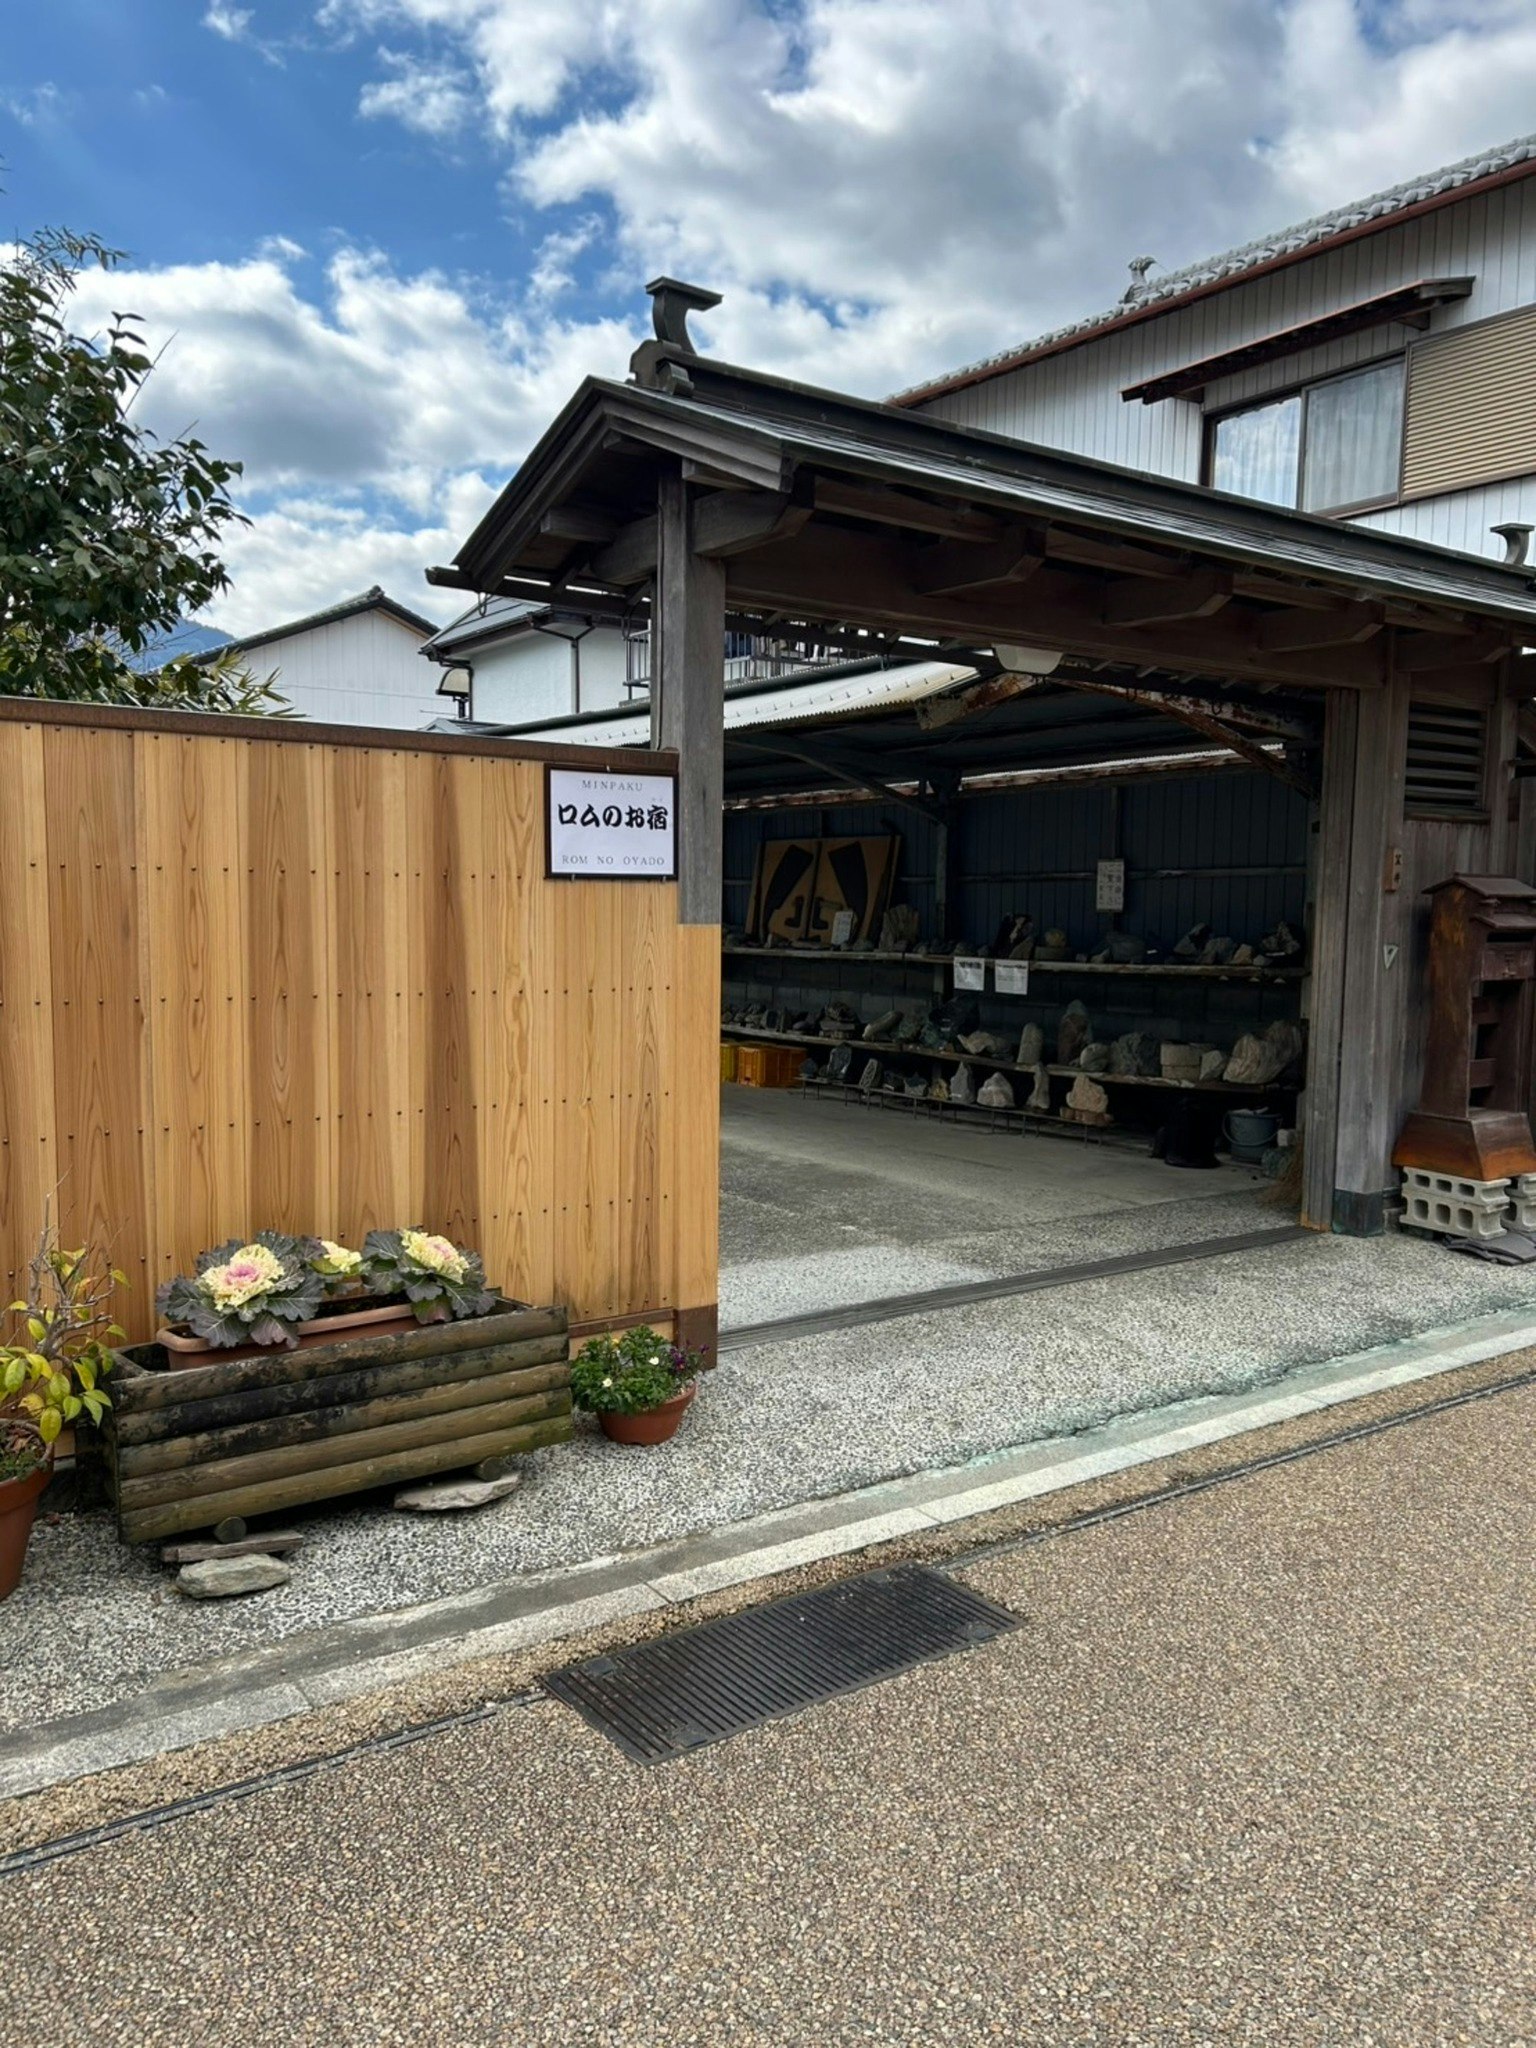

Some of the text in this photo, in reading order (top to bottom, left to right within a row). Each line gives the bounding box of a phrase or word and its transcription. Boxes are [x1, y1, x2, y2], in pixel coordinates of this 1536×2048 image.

[581, 780, 643, 792] MINPAKU
[558, 803, 668, 830] ロムのお宿
[562, 855, 665, 866] ROM NO OYADO
